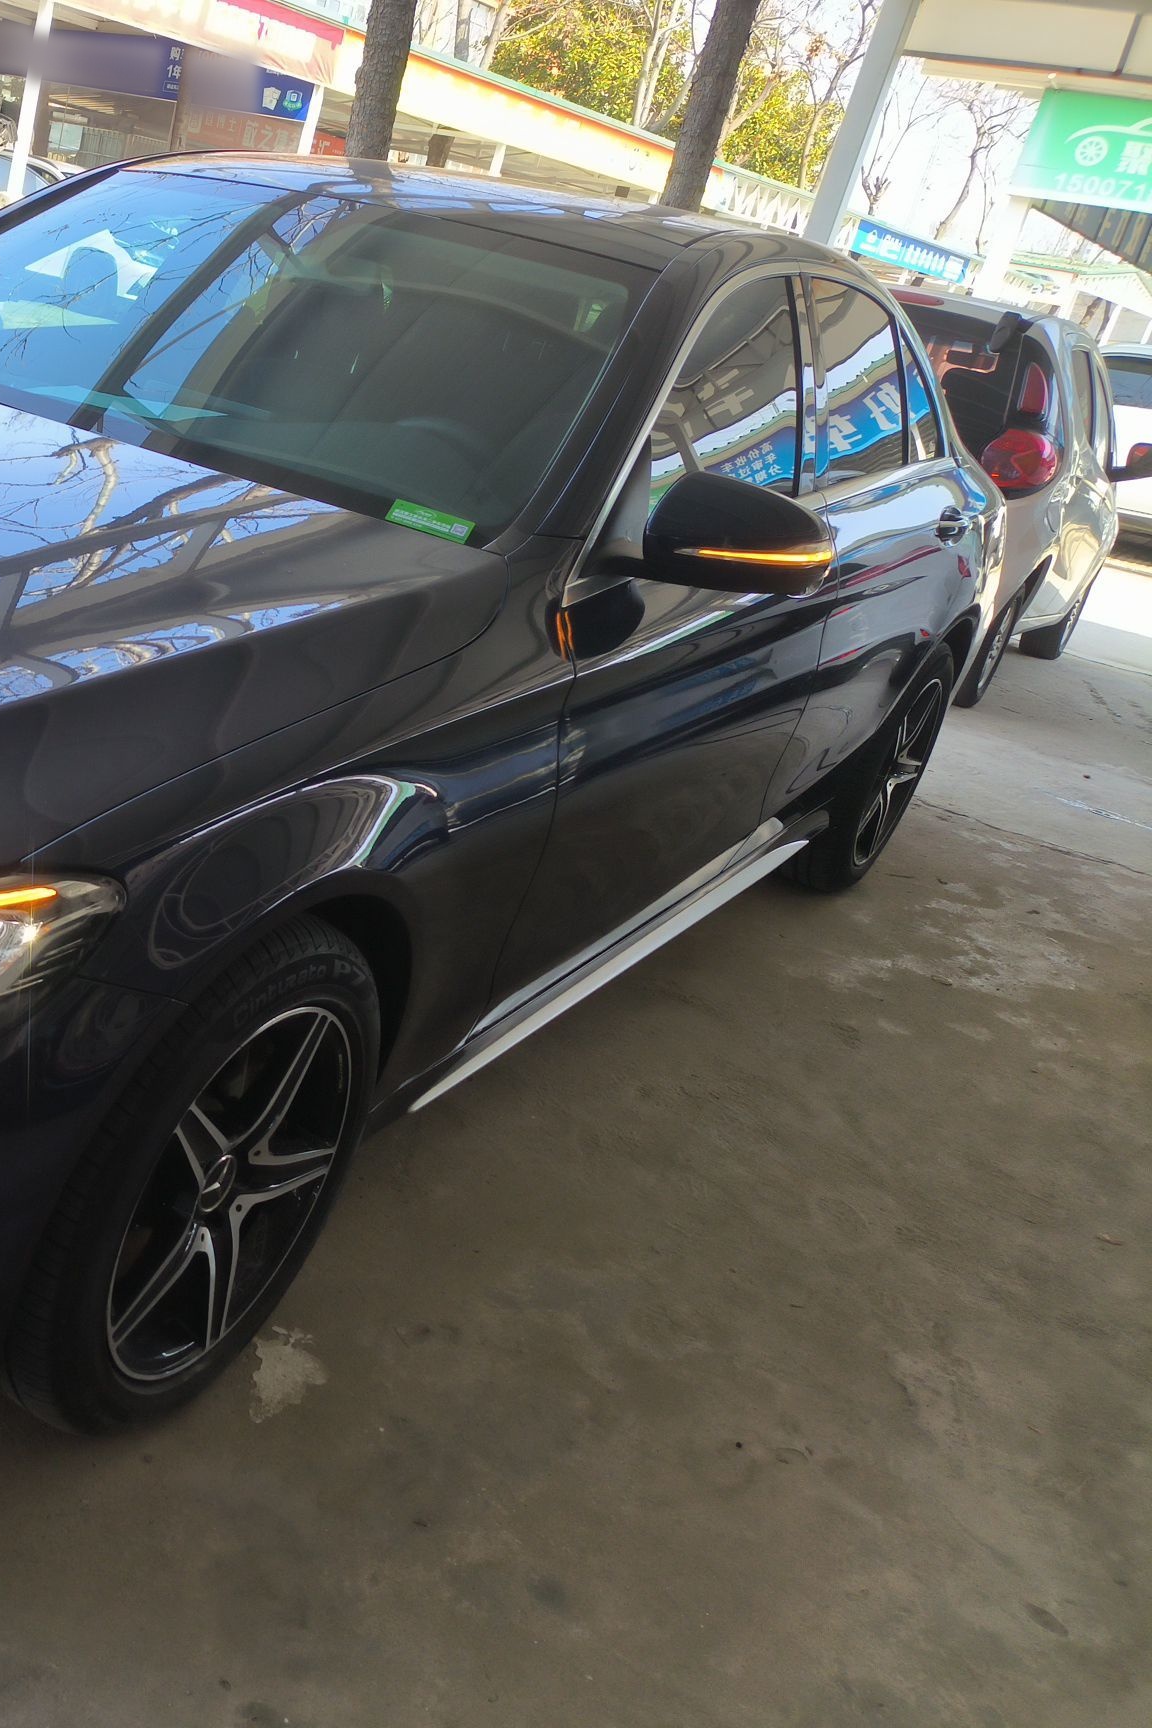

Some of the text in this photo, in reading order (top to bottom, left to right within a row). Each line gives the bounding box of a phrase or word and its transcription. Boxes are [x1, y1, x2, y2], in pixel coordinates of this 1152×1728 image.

[169, 46, 184, 61] 购
[1054, 172, 1152, 203] 150071
[331, 959, 367, 985] P7
